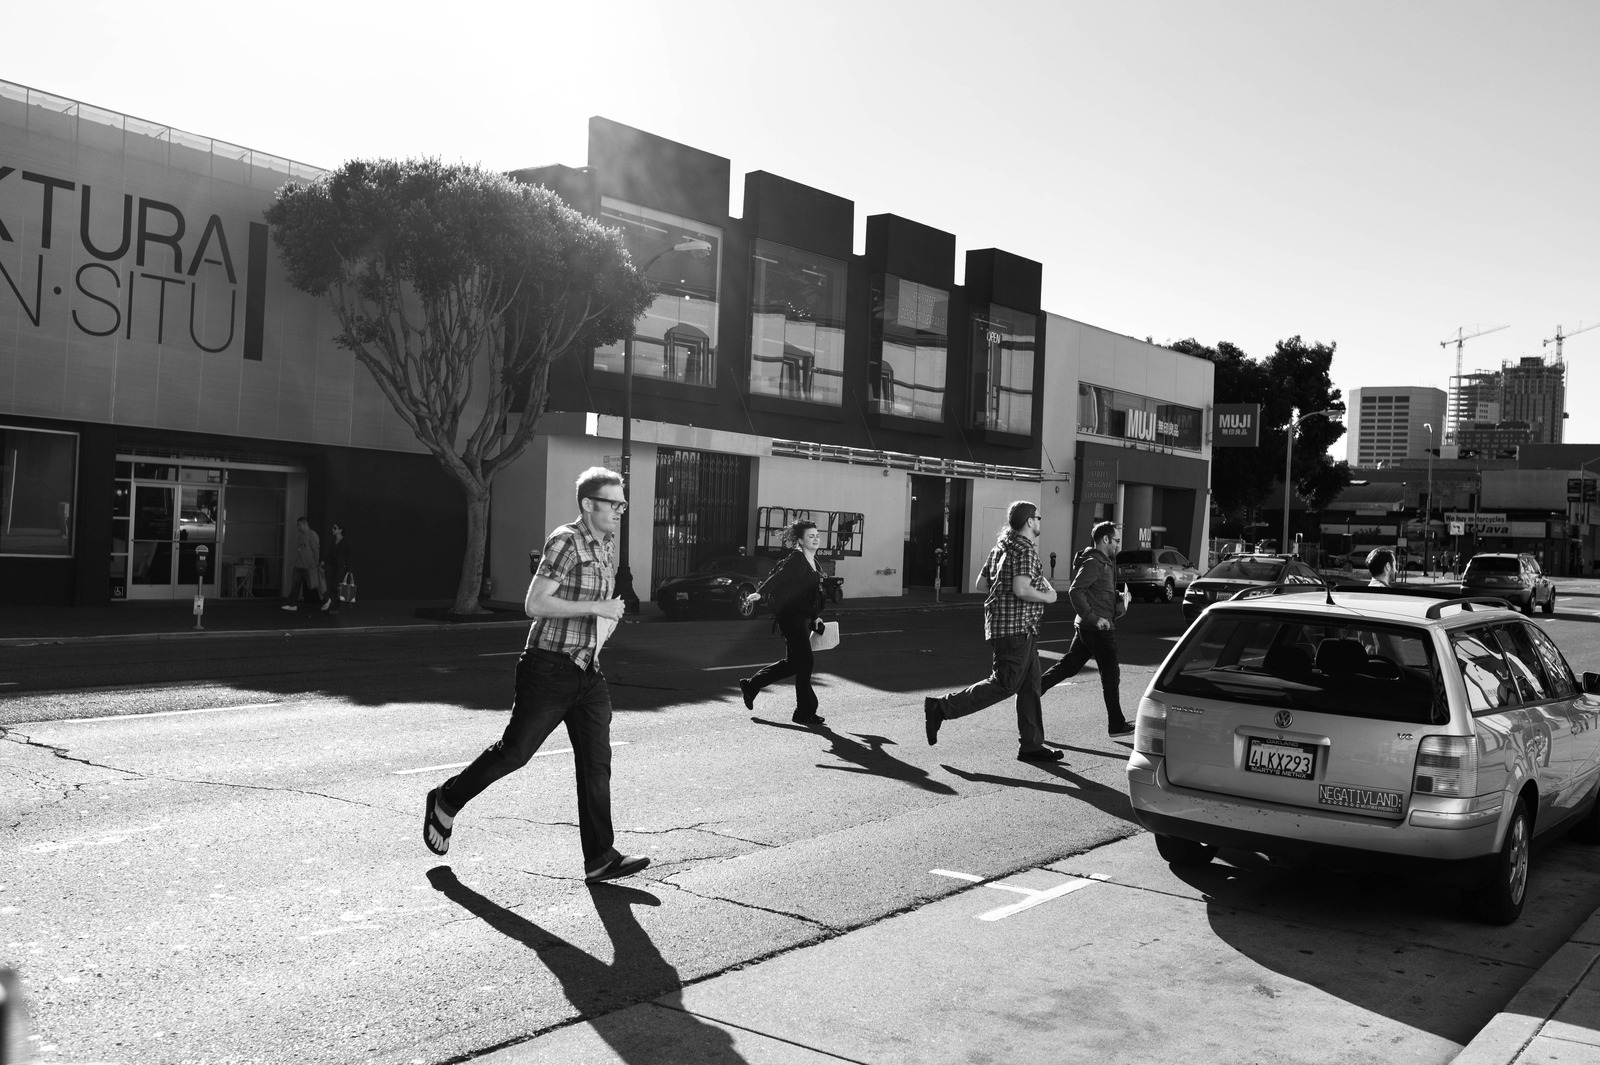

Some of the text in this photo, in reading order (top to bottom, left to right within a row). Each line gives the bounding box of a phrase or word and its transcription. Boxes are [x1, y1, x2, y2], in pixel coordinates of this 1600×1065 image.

[987, 331, 1000, 343] OPEN
[1128, 408, 1156, 441] MUJI
[1219, 414, 1251, 428] MUJI
[1171, 705, 1205, 714] PASSAT
[1266, 739, 1298, 747] OAKLAND
[1251, 750, 1310, 773] 4LKX293
[1251, 766, 1281, 775] MARTY'S
